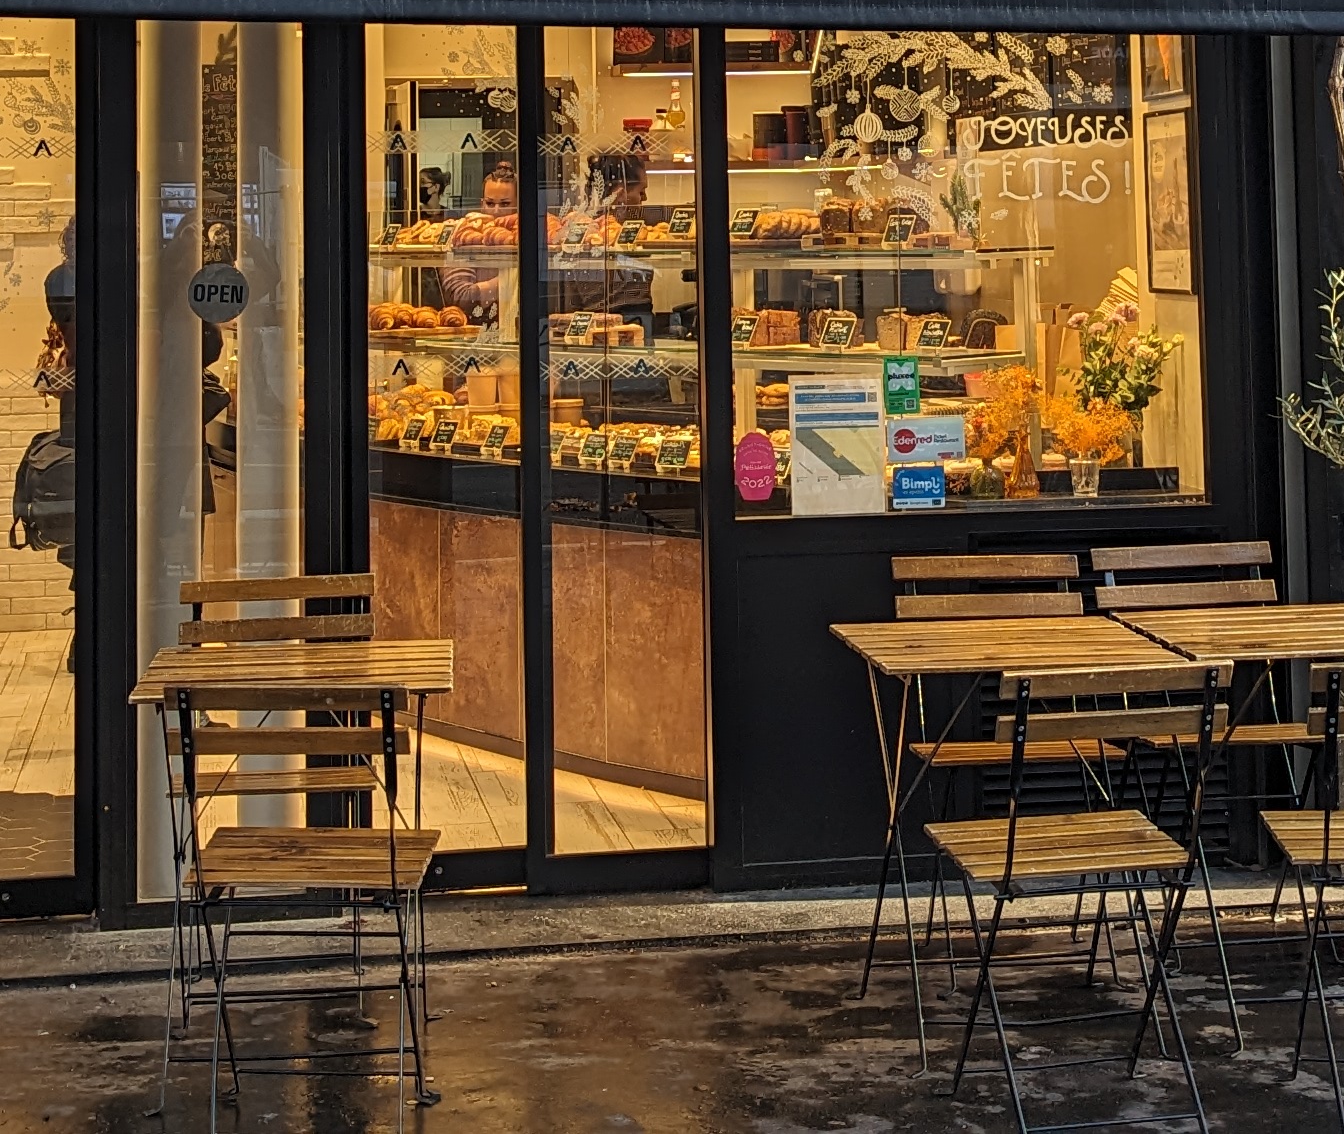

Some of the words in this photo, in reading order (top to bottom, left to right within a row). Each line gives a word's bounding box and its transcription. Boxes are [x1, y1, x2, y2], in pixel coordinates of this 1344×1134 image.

[962, 113, 1129, 150] JOYEUSES
[963, 152, 1111, 204] FÊTES
[193, 283, 244, 304] OPEN
[893, 434, 933, 446] Edenred
[740, 475, 773, 489] 2022
